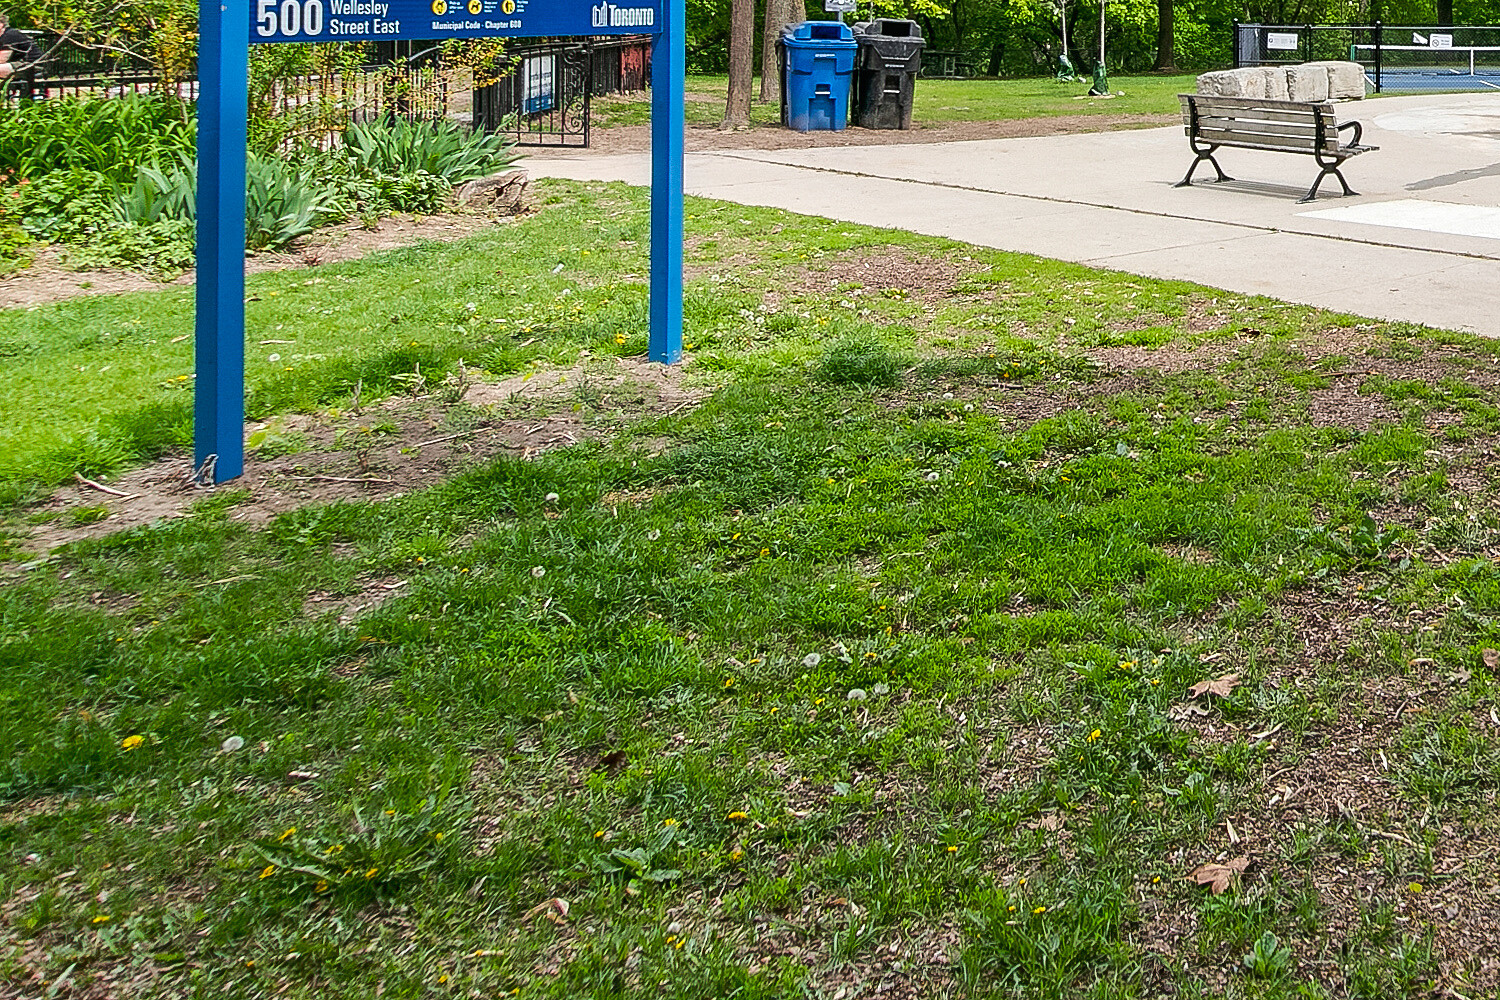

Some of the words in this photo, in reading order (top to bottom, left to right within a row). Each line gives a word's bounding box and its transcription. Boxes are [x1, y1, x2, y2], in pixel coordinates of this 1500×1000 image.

[329, 0, 389, 18] Wellesley
[608, 4, 654, 27] TORONTO
[329, 18, 370, 35] Street
[373, 18, 400, 34] East
[431, 21, 464, 31] Municipal
[465, 20, 480, 30] Code
